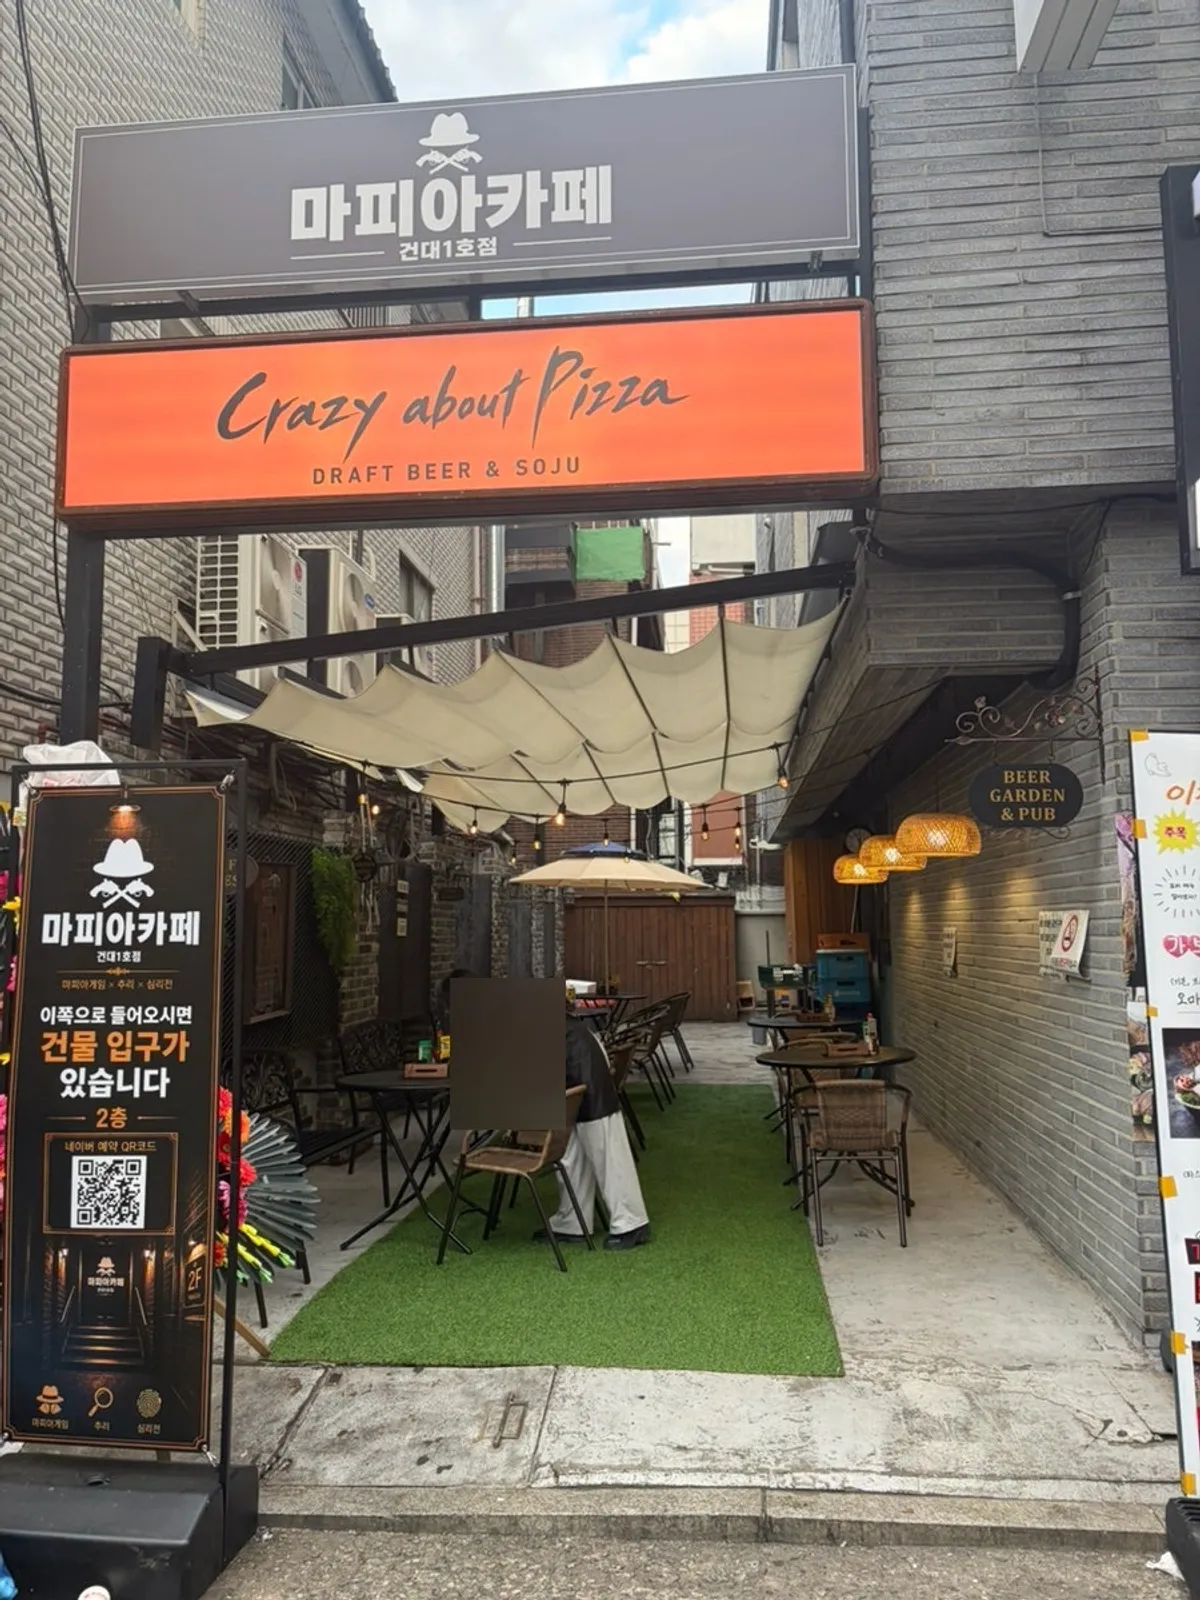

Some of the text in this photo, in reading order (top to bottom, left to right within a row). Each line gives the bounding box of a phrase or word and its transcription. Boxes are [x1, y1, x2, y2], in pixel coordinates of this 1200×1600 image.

[290, 165, 612, 241] 마피아카페
[399, 236, 497, 261] 건대1호점
[217, 345, 690, 464] Crazy about Pizza
[313, 457, 580, 485] DRAFT BEER & SOJU
[1003, 770, 1051, 784] BEER
[989, 788, 1066, 803] GARDEN
[1166, 780, 1200, 806] 이
[1000, 807, 1056, 821] & PUB
[41, 911, 200, 947] 마피아카페
[96, 950, 142, 963] 건대1호점
[40, 1005, 193, 1025] 이쪽으로 들어오시면
[41, 1030, 190, 1063] 건물 입구가
[59, 1067, 171, 1099] 있습니다
[96, 1106, 128, 1128] 2층
[64, 1140, 157, 1152] 네이버 예약 QR코드
[187, 1266, 203, 1292] 2F
